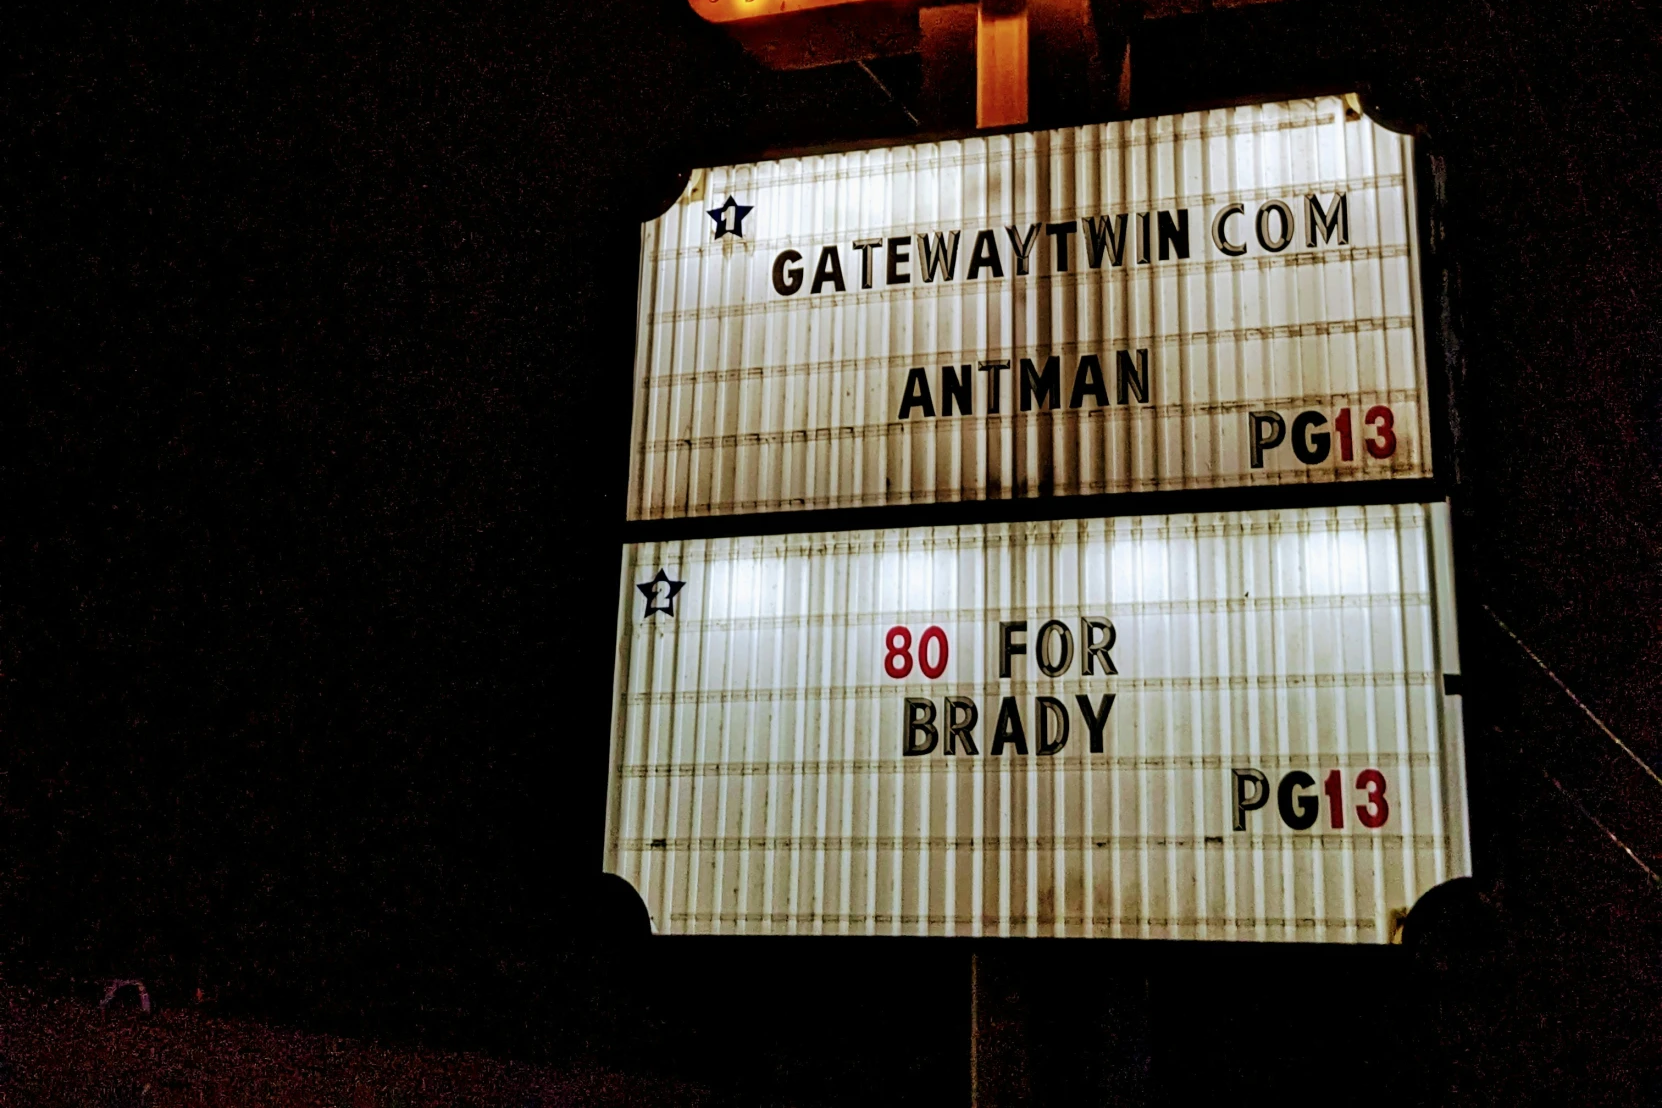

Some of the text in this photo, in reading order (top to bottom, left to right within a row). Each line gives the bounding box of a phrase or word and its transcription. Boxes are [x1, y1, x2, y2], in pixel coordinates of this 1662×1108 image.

[721, 206, 736, 230] 1
[772, 192, 1349, 297] GATEWAYTWIN COM
[898, 349, 1149, 419] ANTMAN
[1249, 405, 1397, 468] PG13
[651, 581, 671, 608] 2
[884, 616, 1118, 679] 80 FOR
[902, 693, 1116, 756] BRADY
[1231, 768, 1389, 831] PG13
